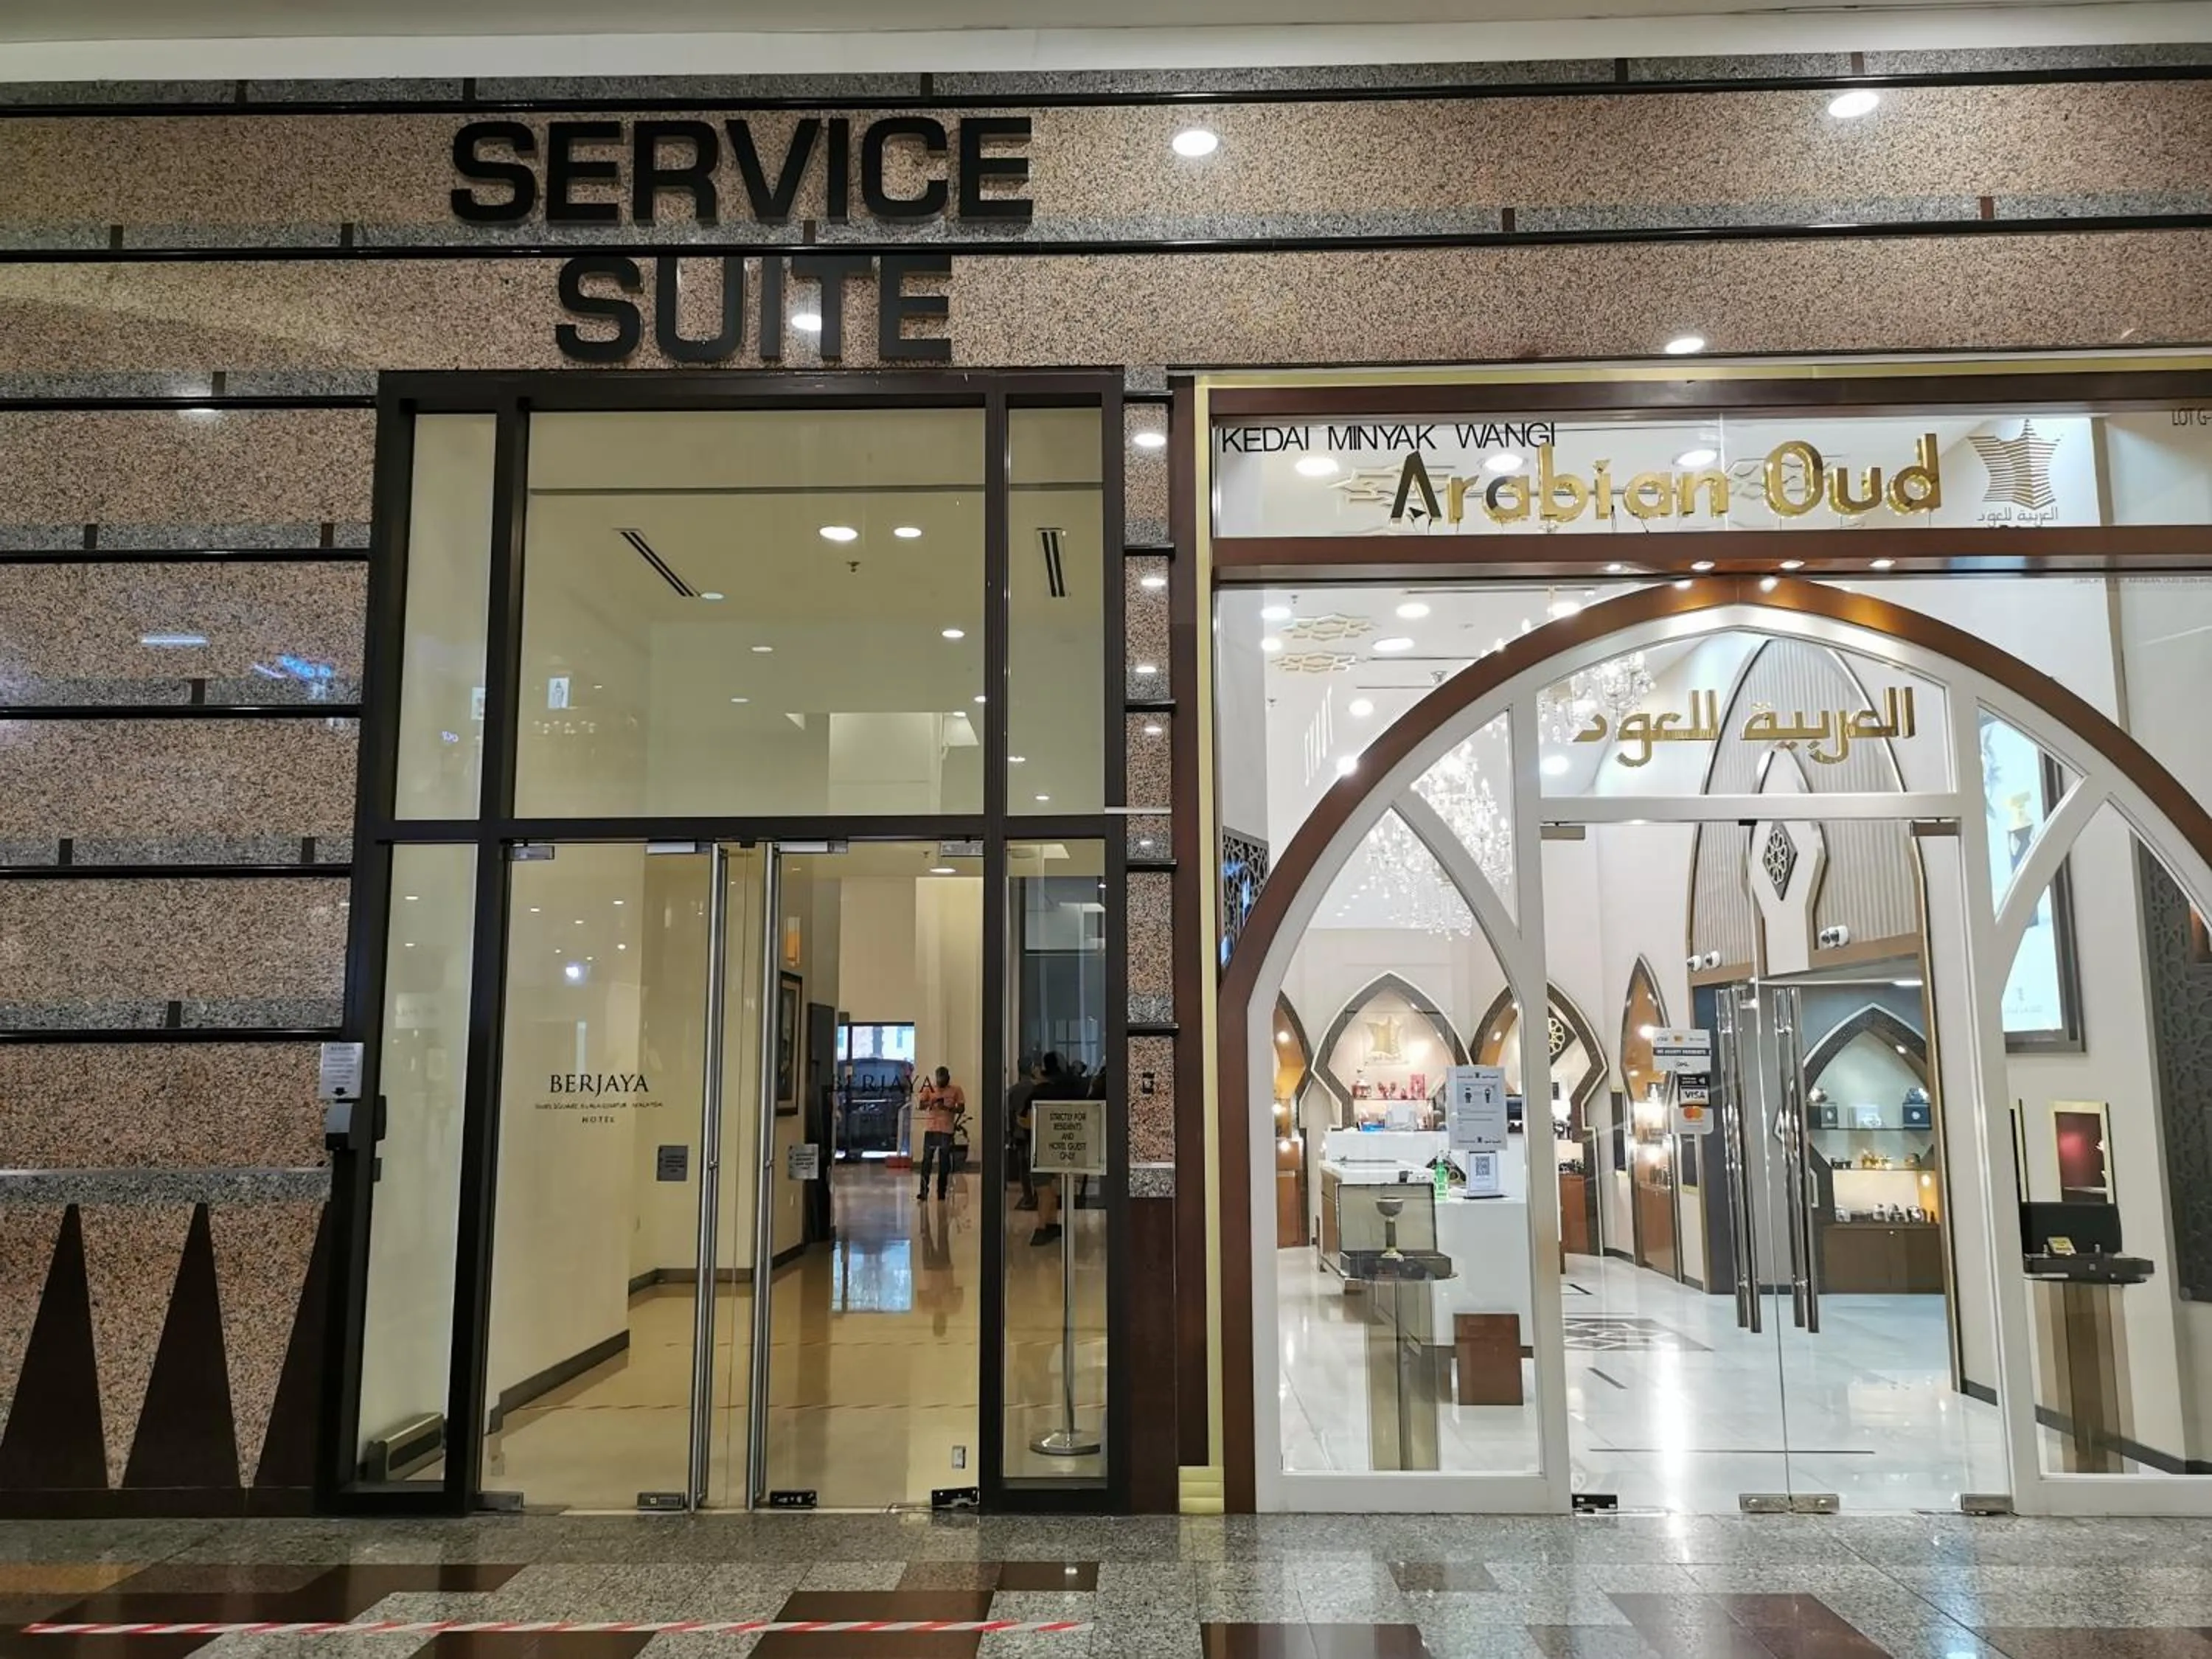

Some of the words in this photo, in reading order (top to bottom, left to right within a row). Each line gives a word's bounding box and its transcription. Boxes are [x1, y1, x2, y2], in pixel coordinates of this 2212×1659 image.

[450, 116, 1032, 225] SERVICE
[555, 254, 953, 361] SUITE
[1222, 425, 1310, 452] KEDAI
[1328, 424, 1437, 451] MINYAK
[1455, 422, 1556, 448] WANGI
[2171, 407, 2195, 425] LOT
[1390, 442, 1730, 524] Arabian
[1763, 433, 1942, 517] Oud
[1572, 689, 1720, 768] للعود
[1739, 686, 1917, 765] العربية
[549, 1074, 649, 1097] BERJAYA
[1685, 1091, 1705, 1099] VISA
